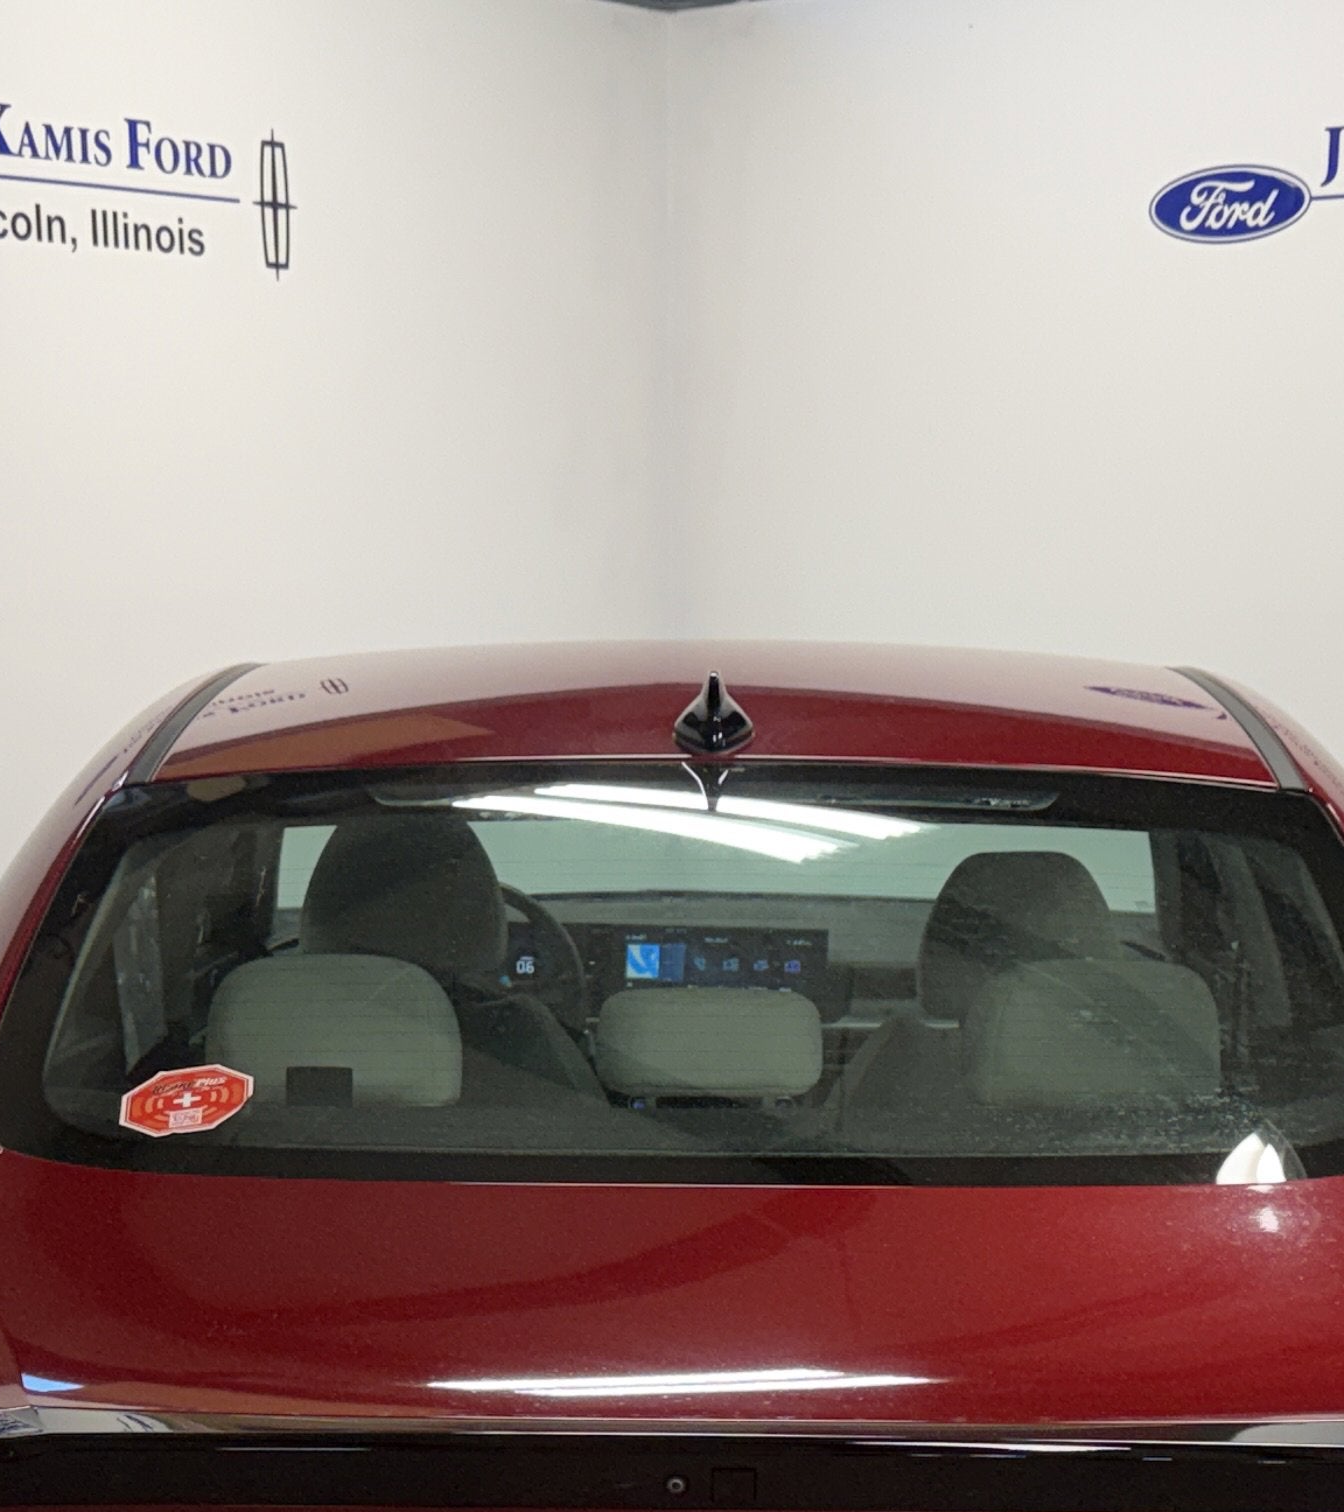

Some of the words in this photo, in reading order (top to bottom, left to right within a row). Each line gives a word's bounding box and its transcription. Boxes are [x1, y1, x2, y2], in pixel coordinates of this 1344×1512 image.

[124, 117, 233, 180] FORD
[1179, 180, 1276, 231] Ford
[90, 208, 206, 257] Illinois
